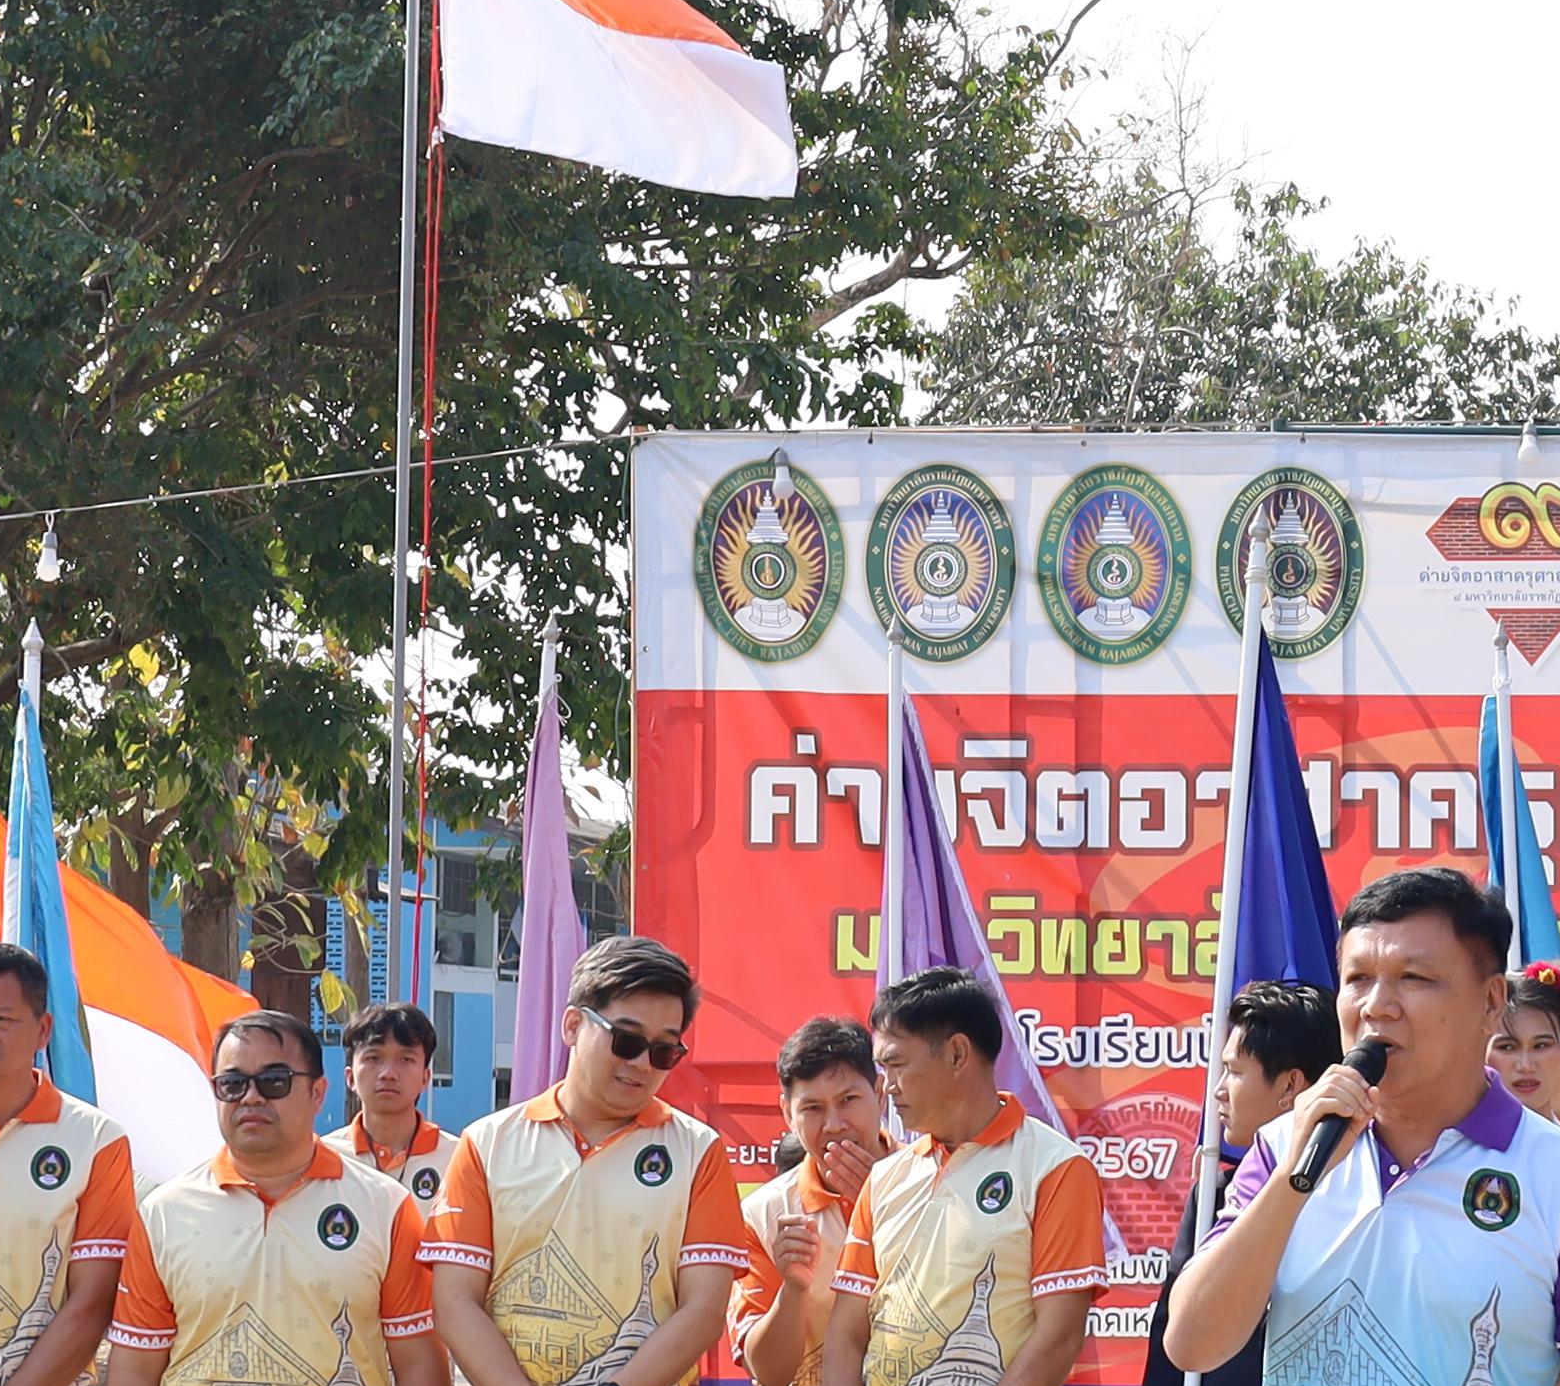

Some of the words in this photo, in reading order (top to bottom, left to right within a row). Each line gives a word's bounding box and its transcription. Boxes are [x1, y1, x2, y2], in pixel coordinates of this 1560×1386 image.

[759, 627, 819, 660] RAJABHAT
[817, 549, 845, 623] UNIVERSITY
[925, 638, 971, 661] RAJABHAT
[971, 586, 1008, 647] UNIVERSITY
[1097, 635, 1155, 663] RAJABHAT
[1152, 570, 1188, 638] UNIVERSITY
[1269, 634, 1328, 656] AJABHAT
[1328, 565, 1364, 633] UNIVERSITY
